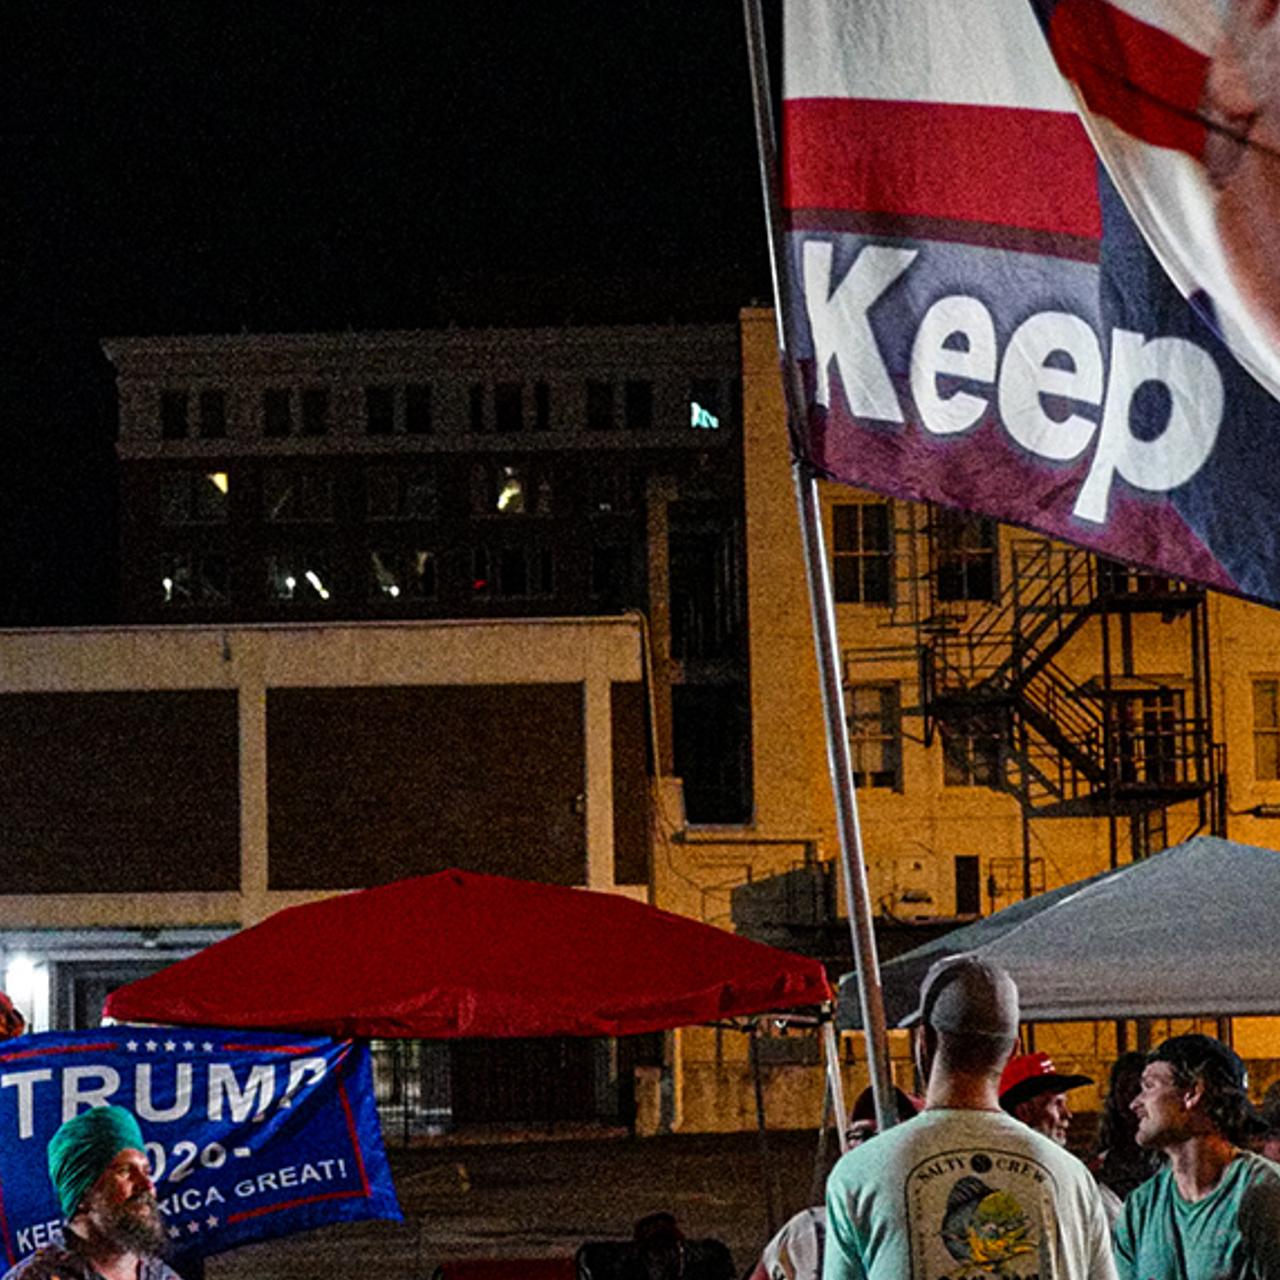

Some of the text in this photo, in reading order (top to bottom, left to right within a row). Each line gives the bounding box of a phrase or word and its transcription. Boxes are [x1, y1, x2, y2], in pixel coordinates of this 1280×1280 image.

[803, 240, 1224, 523] Keep
[1, 1057, 327, 1140] TRUMP
[234, 1159, 347, 1198] GREAT!
